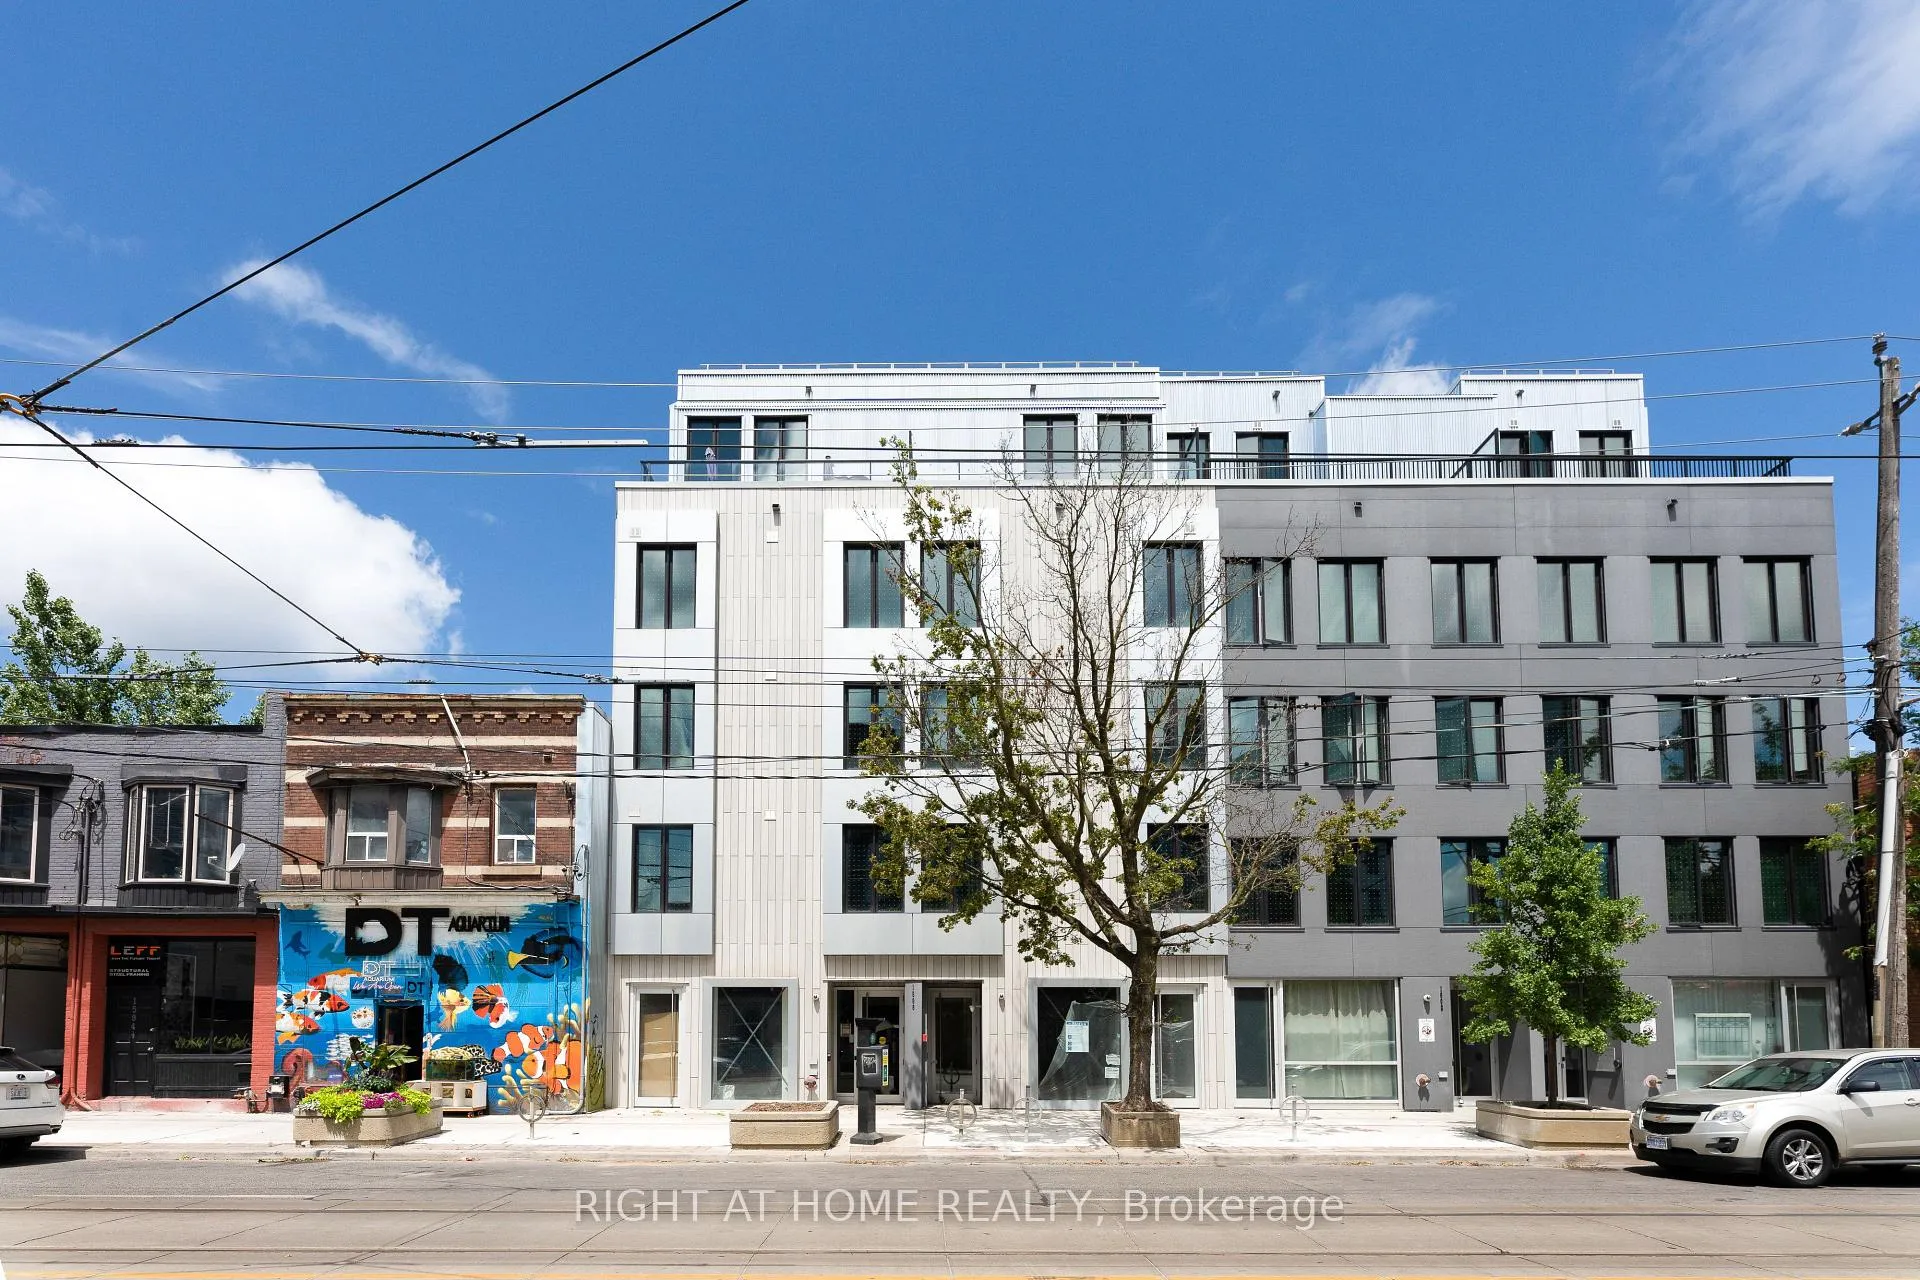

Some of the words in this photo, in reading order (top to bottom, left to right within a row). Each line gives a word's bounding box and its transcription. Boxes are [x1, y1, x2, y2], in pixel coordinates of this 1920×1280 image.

[345, 908, 449, 956] DT
[448, 916, 510, 932] AQUARIUM
[110, 946, 160, 956] LEFF
[363, 961, 396, 977] DT
[408, 982, 425, 993] DT
